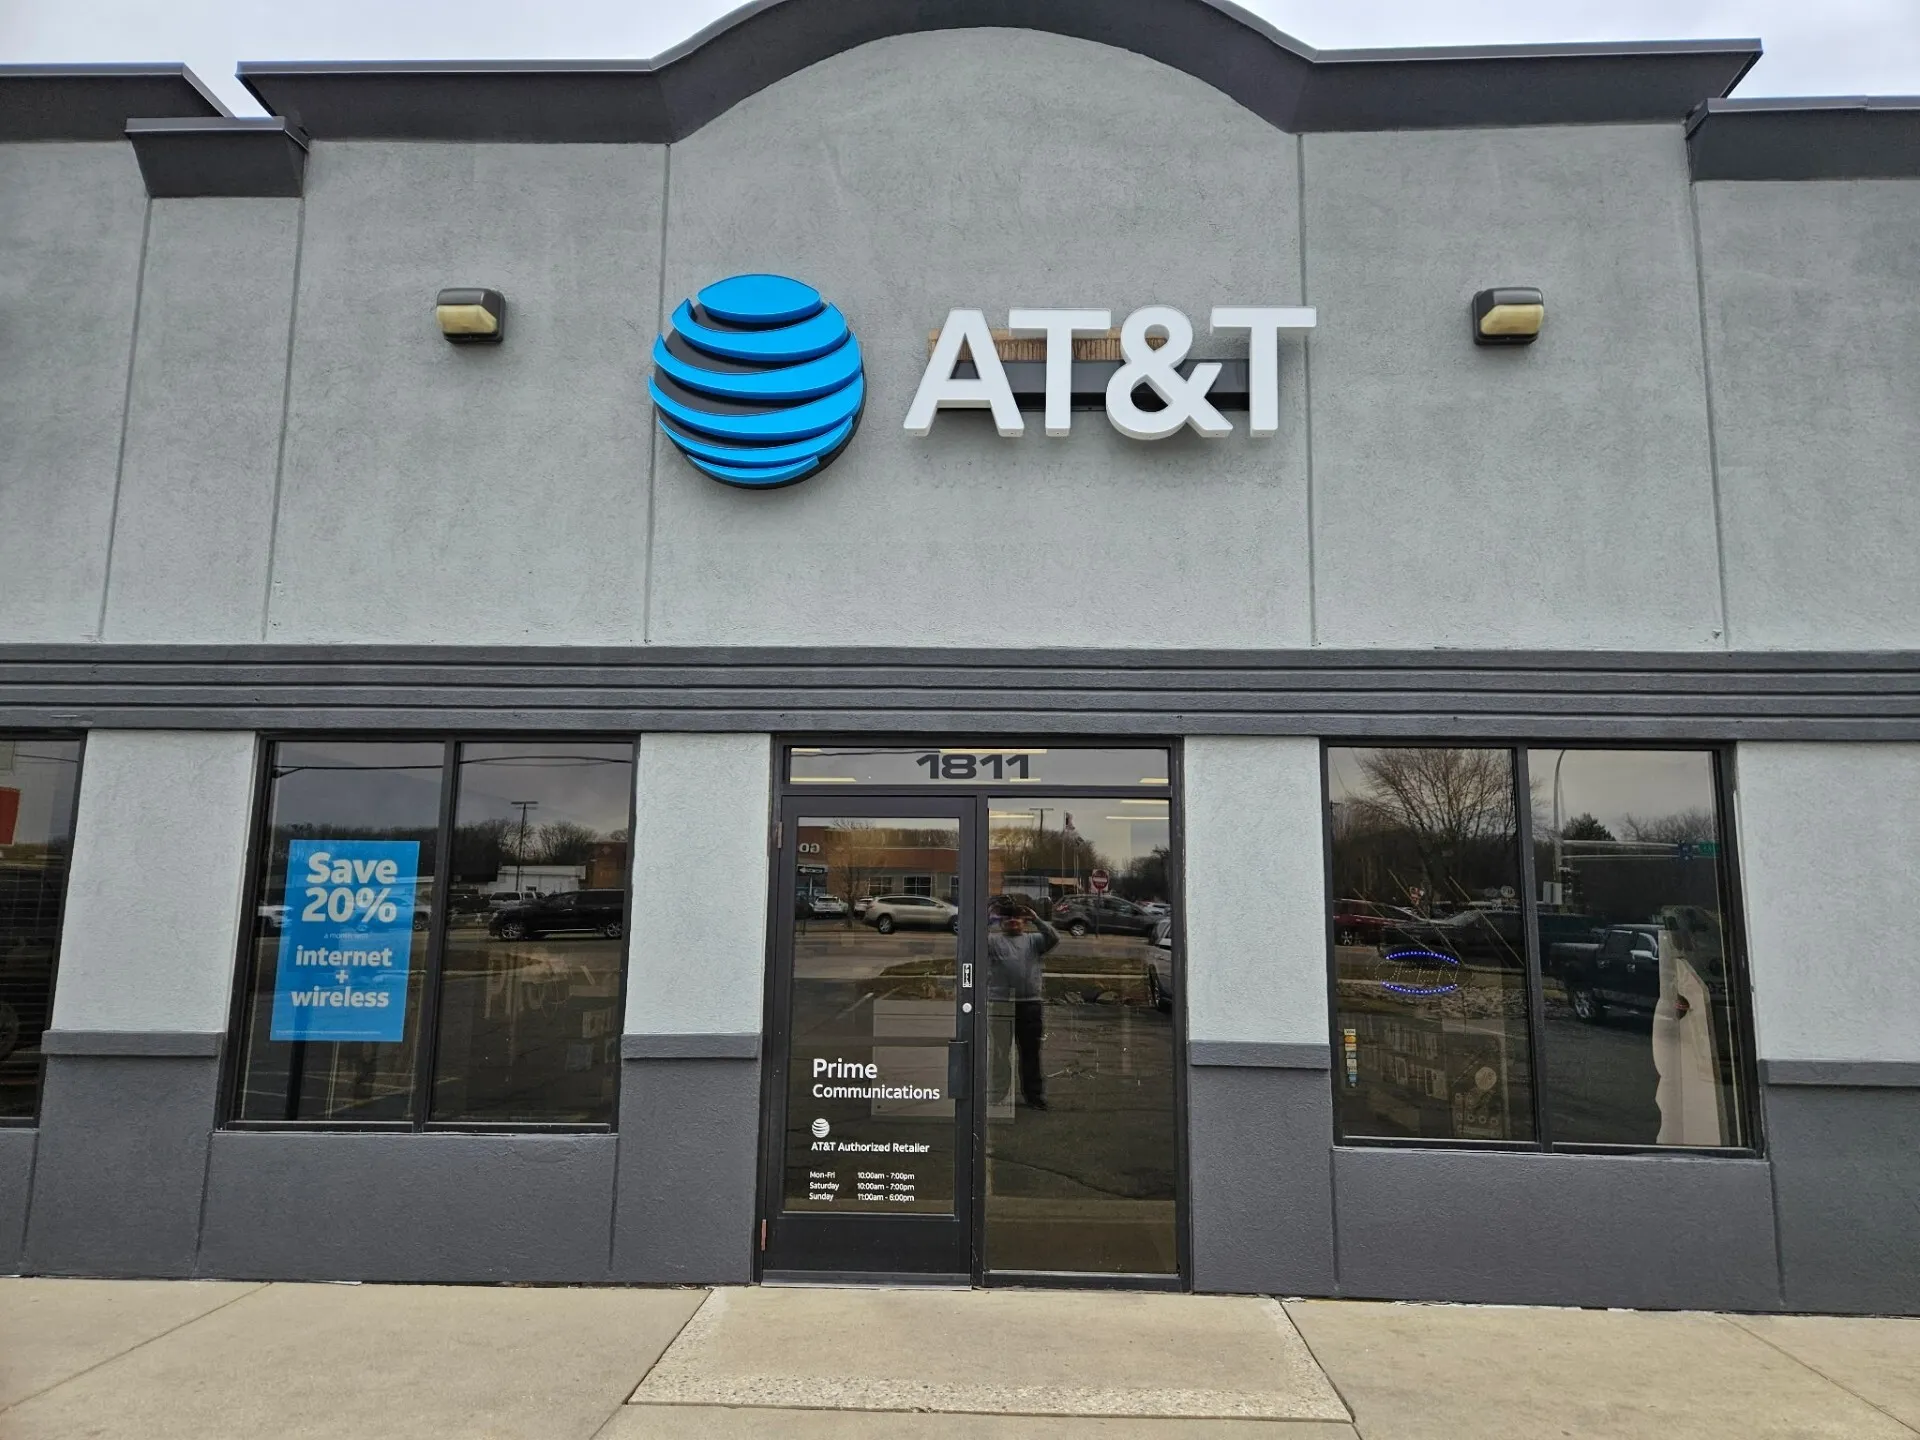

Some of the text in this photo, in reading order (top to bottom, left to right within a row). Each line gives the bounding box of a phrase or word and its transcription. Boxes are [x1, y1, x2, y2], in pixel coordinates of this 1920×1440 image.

[903, 305, 1317, 440] AT&T
[916, 754, 1029, 780] 1811
[306, 851, 398, 884] Save
[301, 886, 398, 923] 20%
[295, 944, 393, 967] internet
[290, 985, 390, 1008] wireless
[813, 1058, 878, 1078] Prime
[812, 1084, 940, 1099] Communications
[811, 1141, 930, 1153] AT&T Authorized Retailer
[809, 1171, 836, 1179] Mon-Fri
[857, 1172, 885, 1180] 10:00am
[890, 1172, 915, 1181] 7:00pm
[809, 1181, 839, 1191] Saturday
[857, 1182, 885, 1191] 10:00am
[890, 1183, 915, 1192] 7:00pm
[809, 1192, 834, 1202] Sunday
[857, 1193, 884, 1201] 11:00am
[889, 1193, 915, 1203] 6:00pm
